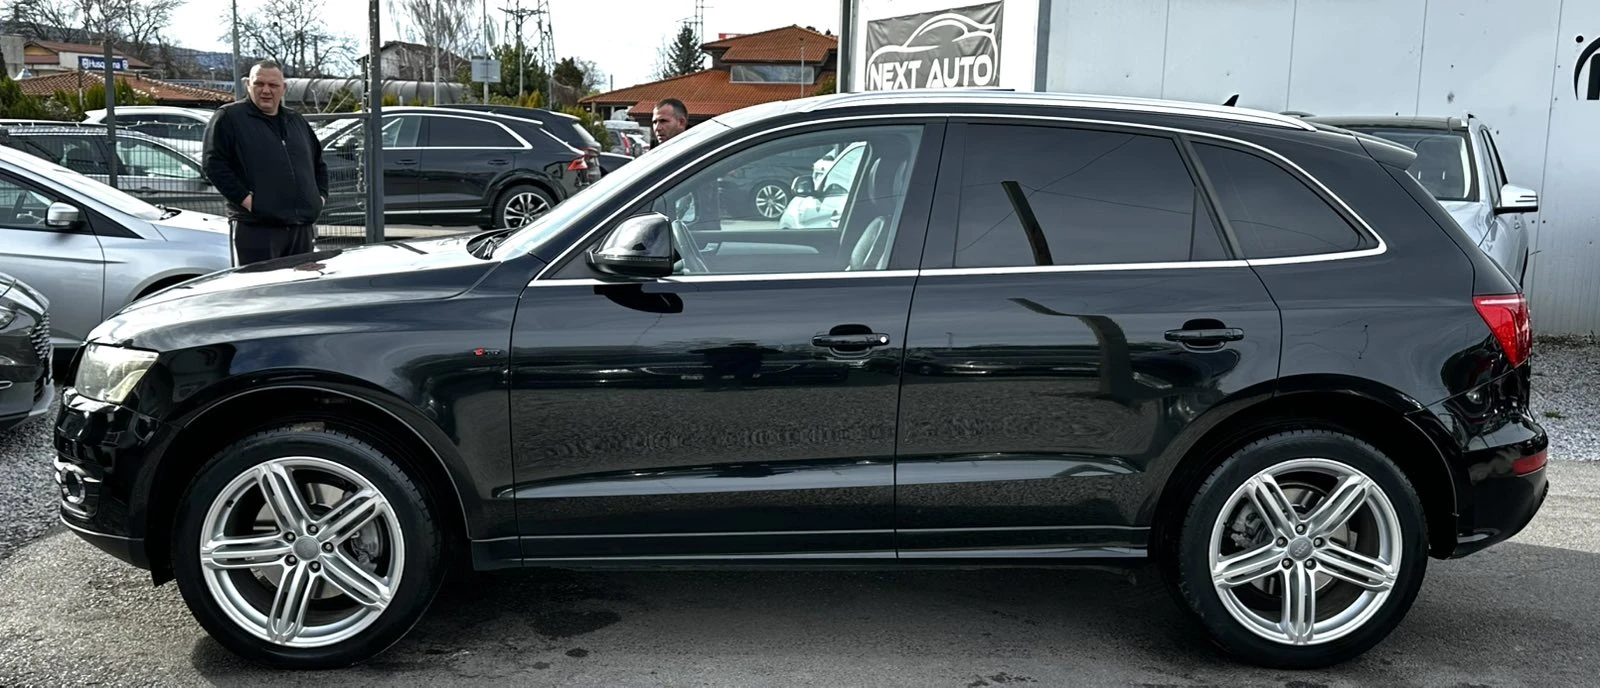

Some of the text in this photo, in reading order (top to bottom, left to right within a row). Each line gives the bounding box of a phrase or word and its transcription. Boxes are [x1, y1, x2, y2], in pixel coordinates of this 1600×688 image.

[90, 59, 121, 69] Husqna
[869, 54, 992, 90] NEXT AUTO
